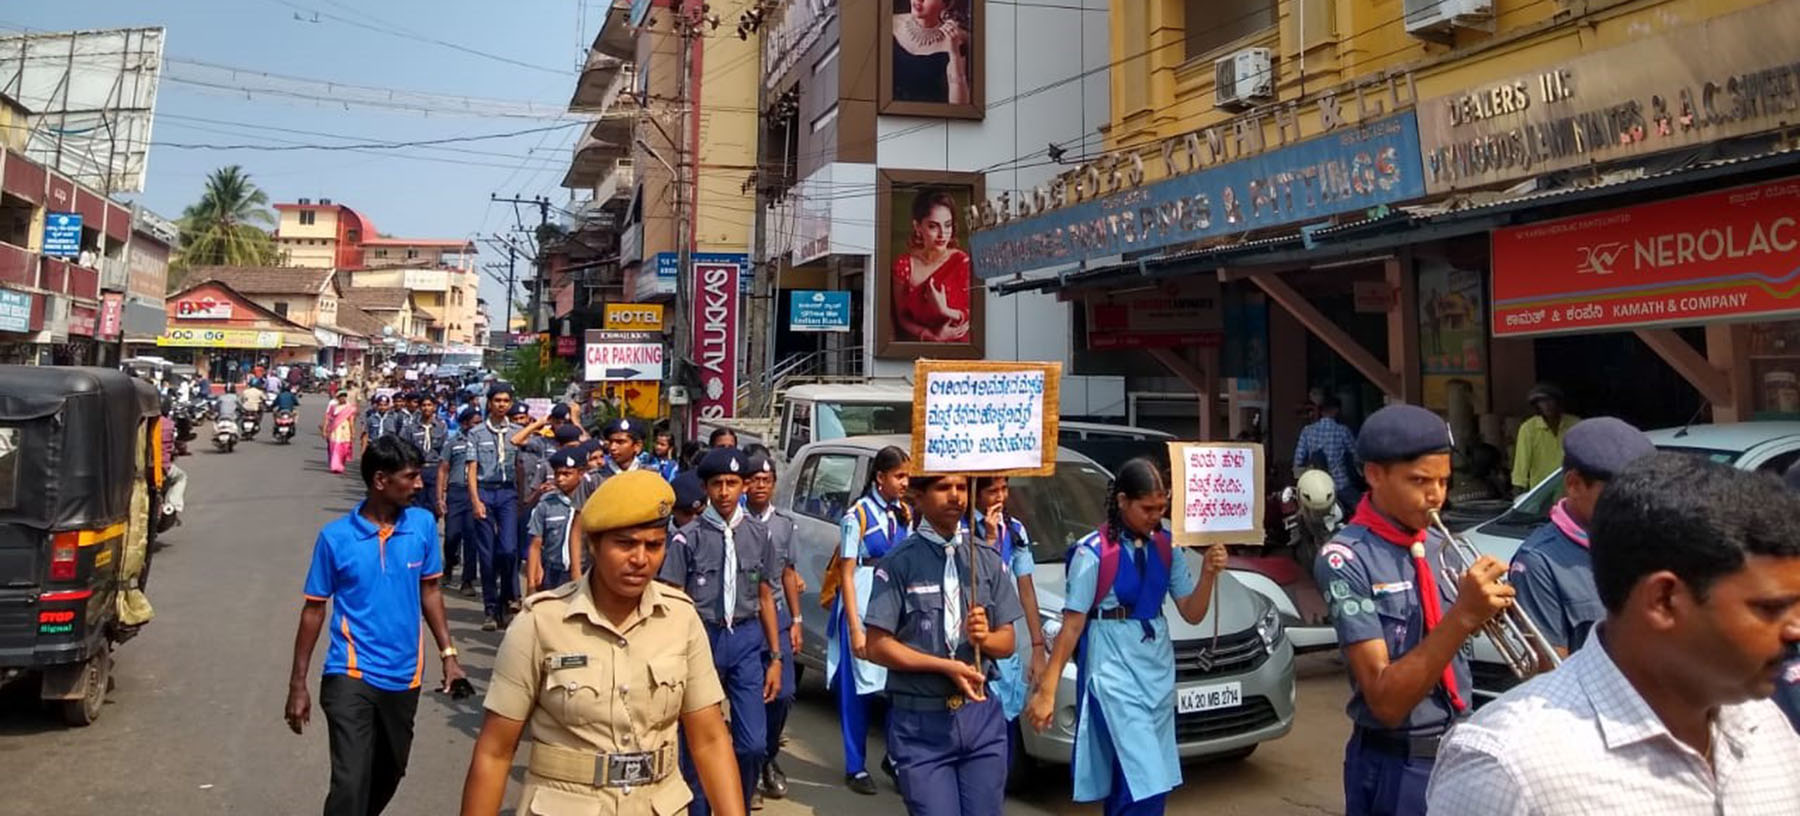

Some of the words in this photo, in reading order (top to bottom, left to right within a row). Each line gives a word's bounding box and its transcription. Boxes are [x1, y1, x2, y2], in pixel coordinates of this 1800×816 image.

[1449, 82, 1529, 127] DEALERS
[1161, 99, 1302, 178] KAMATH
[1317, 91, 1345, 131] &
[1633, 216, 1798, 271] NEROLAC
[1613, 300, 1665, 317] KAMATH
[1668, 299, 1677, 312] &
[1680, 293, 1748, 311] COMPANY
[609, 310, 662, 324] HOTEL
[703, 268, 729, 374] ALUKKAS
[1506, 310, 1545, 326] ಕಾಮತ್
[1552, 310, 1561, 322] &
[587, 346, 609, 364] CAR
[612, 346, 662, 364] PARKING
[40, 611, 75, 623] STOP
[40, 623, 73, 634] Signal
[1181, 694, 1194, 710] KA
[1195, 693, 1206, 708] 20
[1207, 690, 1221, 706] MB
[1222, 688, 1239, 705] 2714
